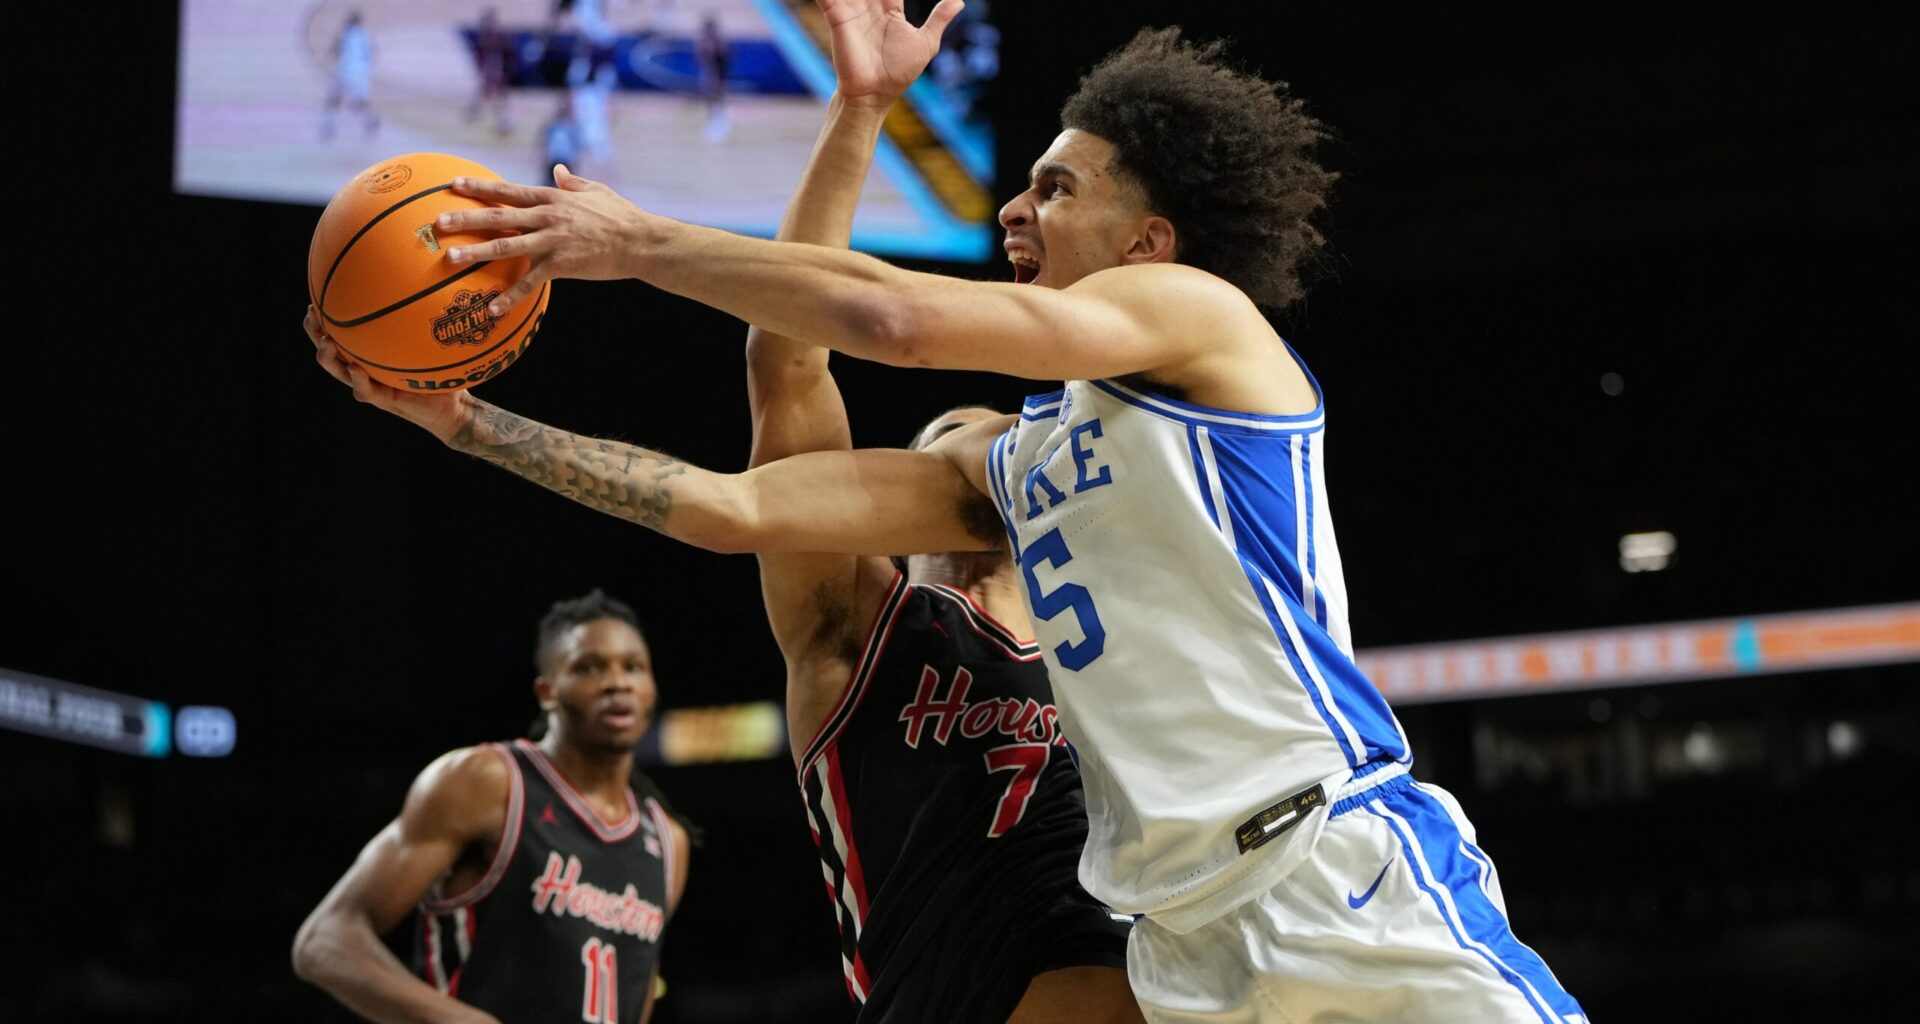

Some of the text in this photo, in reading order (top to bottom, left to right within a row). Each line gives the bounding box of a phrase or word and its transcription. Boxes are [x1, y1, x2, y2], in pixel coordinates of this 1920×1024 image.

[437, 315, 472, 341] FOUR
[1020, 527, 1106, 672] 5
[898, 664, 1067, 749] Hous
[983, 742, 1050, 838] 7
[531, 851, 664, 944] Houston
[581, 936, 619, 1024] 11
